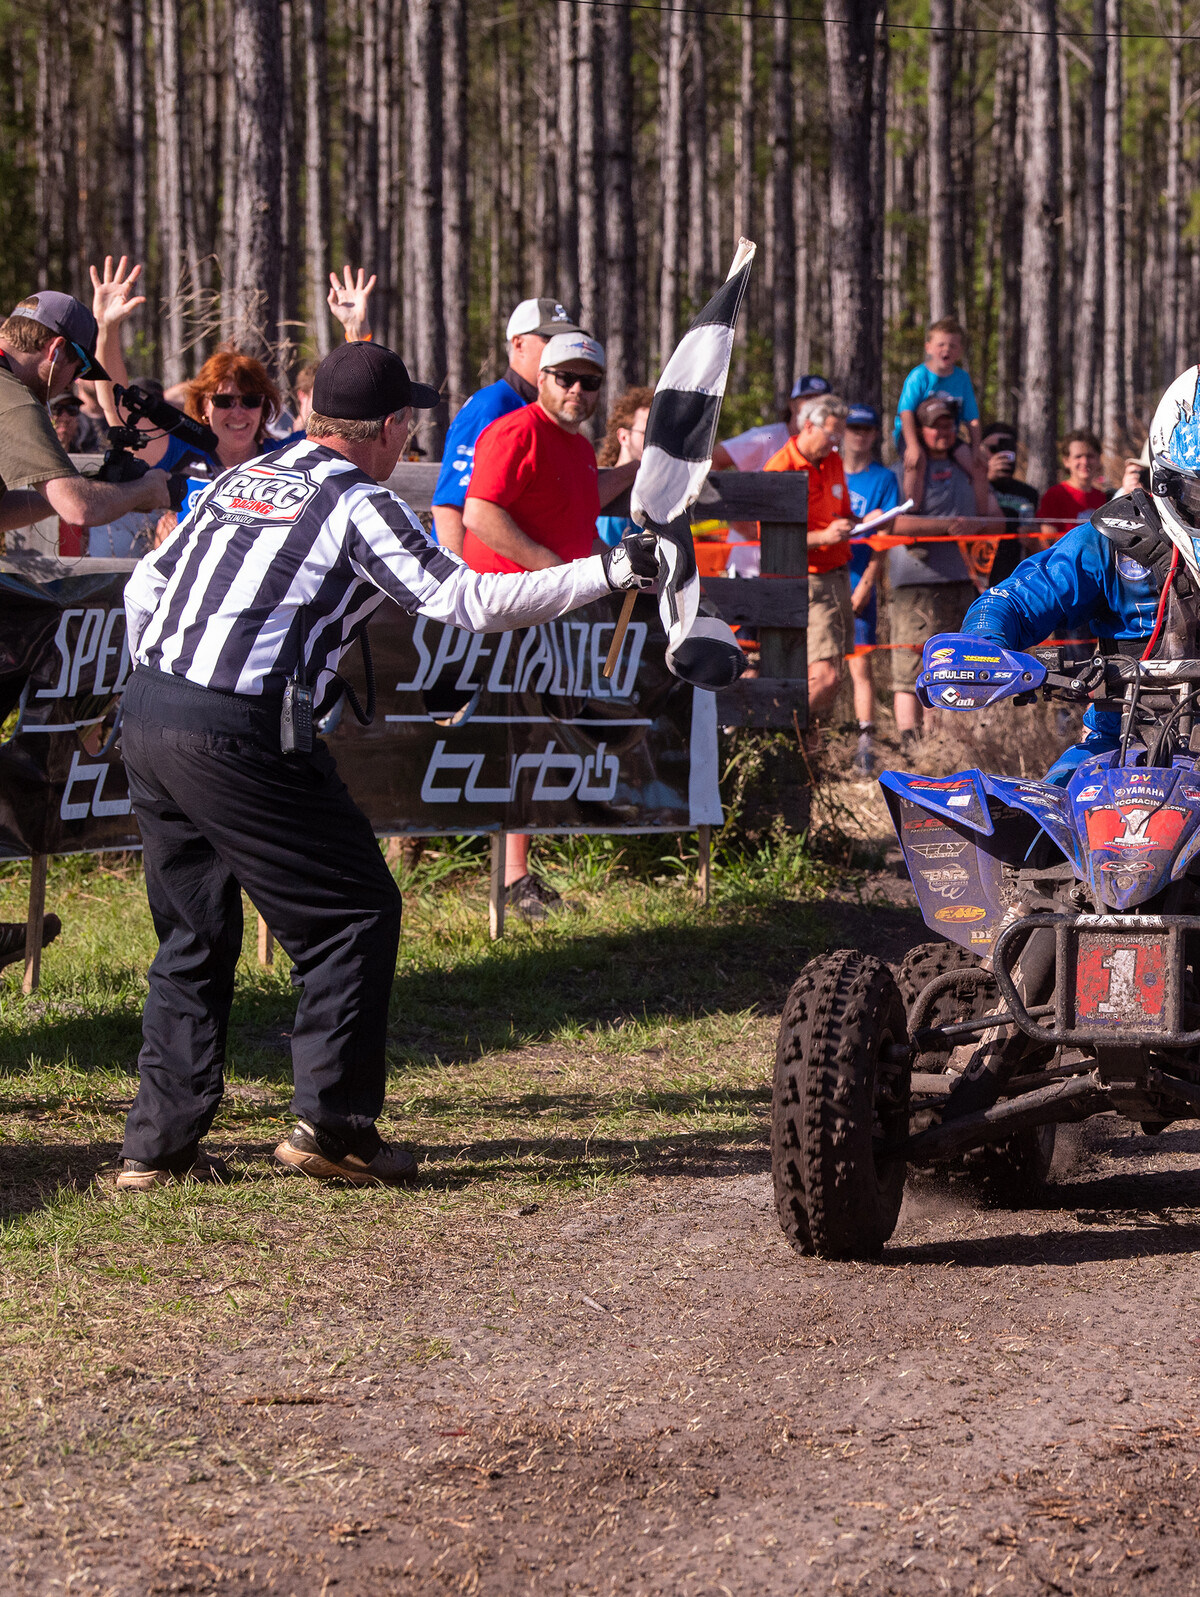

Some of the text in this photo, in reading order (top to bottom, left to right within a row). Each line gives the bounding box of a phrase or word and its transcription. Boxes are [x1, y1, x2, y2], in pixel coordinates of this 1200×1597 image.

[229, 498, 275, 516] RACING
[933, 671, 975, 680] FOWLER
[421, 740, 620, 802] turbo
[1125, 787, 1165, 798] YAMAHA
[1120, 809, 1151, 843] 1
[1074, 914, 1165, 927] RATH
[1098, 949, 1142, 1013] 1
